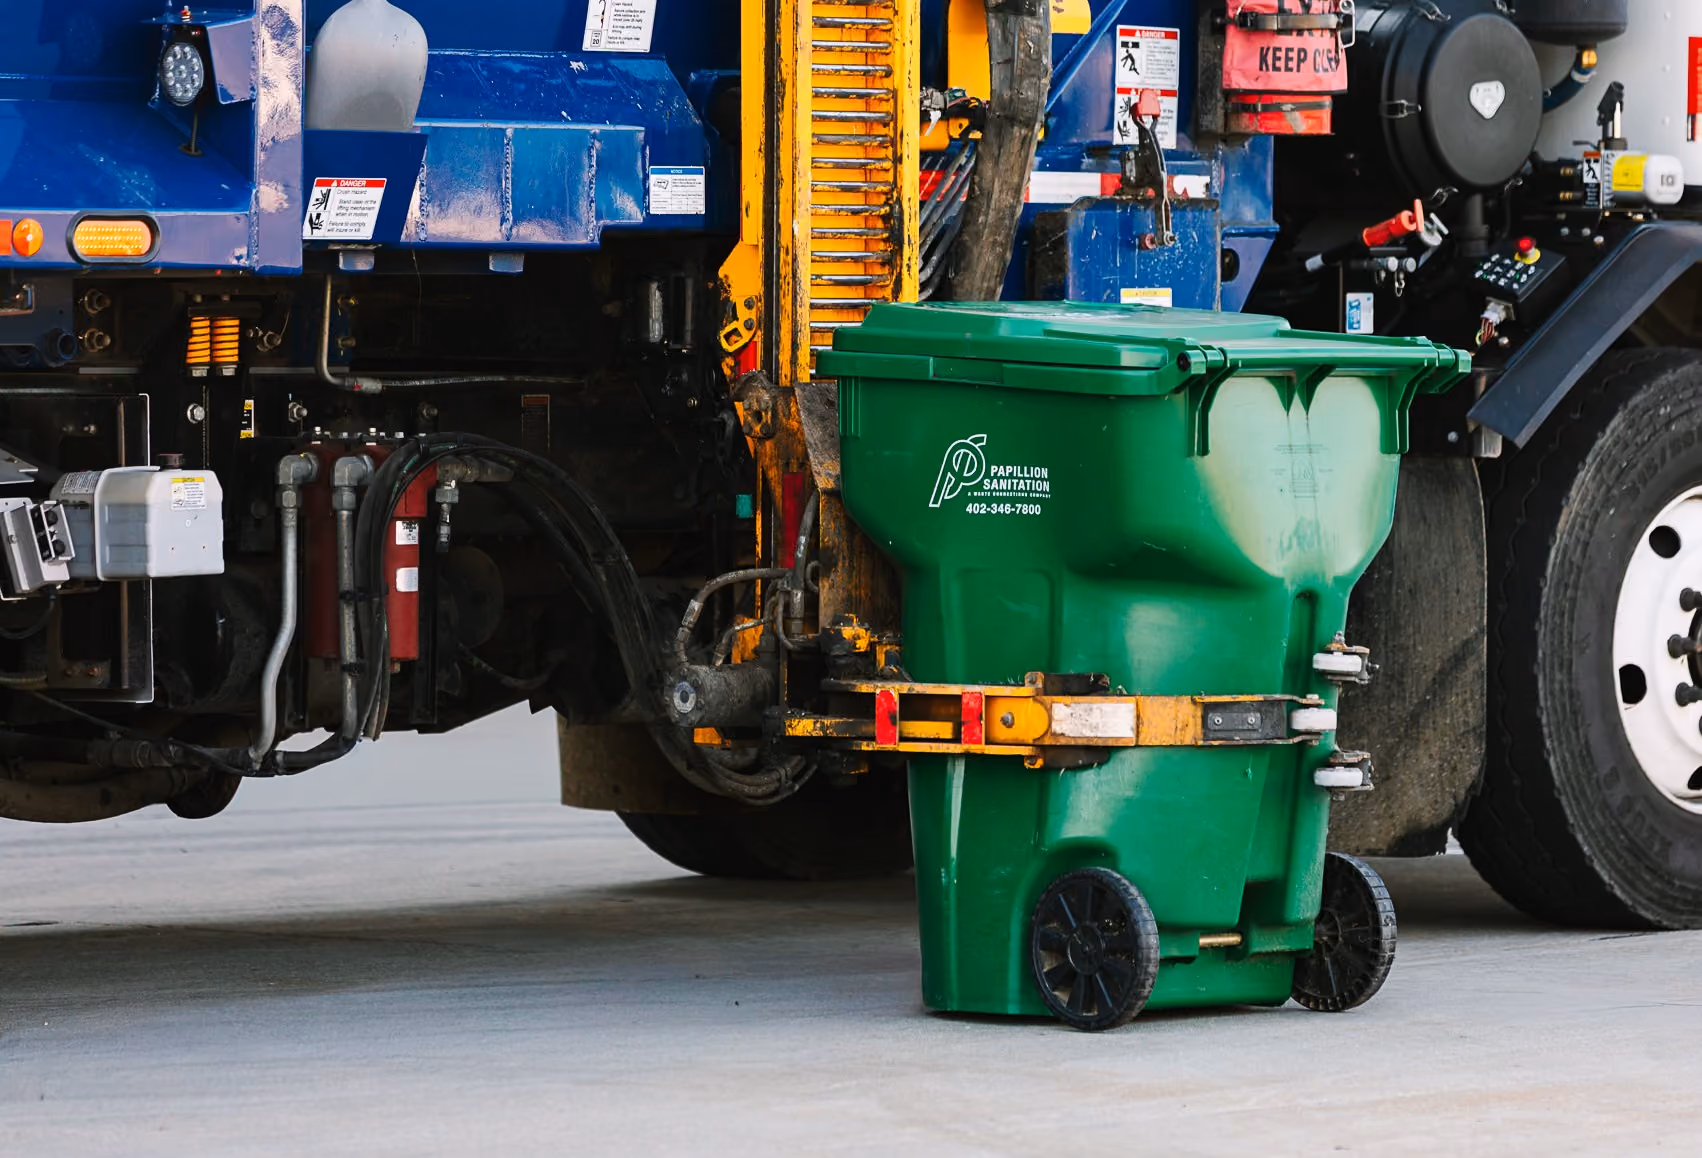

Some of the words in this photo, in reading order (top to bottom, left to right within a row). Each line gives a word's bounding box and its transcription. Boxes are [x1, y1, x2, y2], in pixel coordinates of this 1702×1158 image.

[1141, 30, 1165, 38] DANGER
[1258, 46, 1308, 73] KEEP
[990, 465, 1048, 479] PAPILLION
[983, 479, 1050, 492] SANITATION
[966, 503, 1042, 516] 402-346-7800
